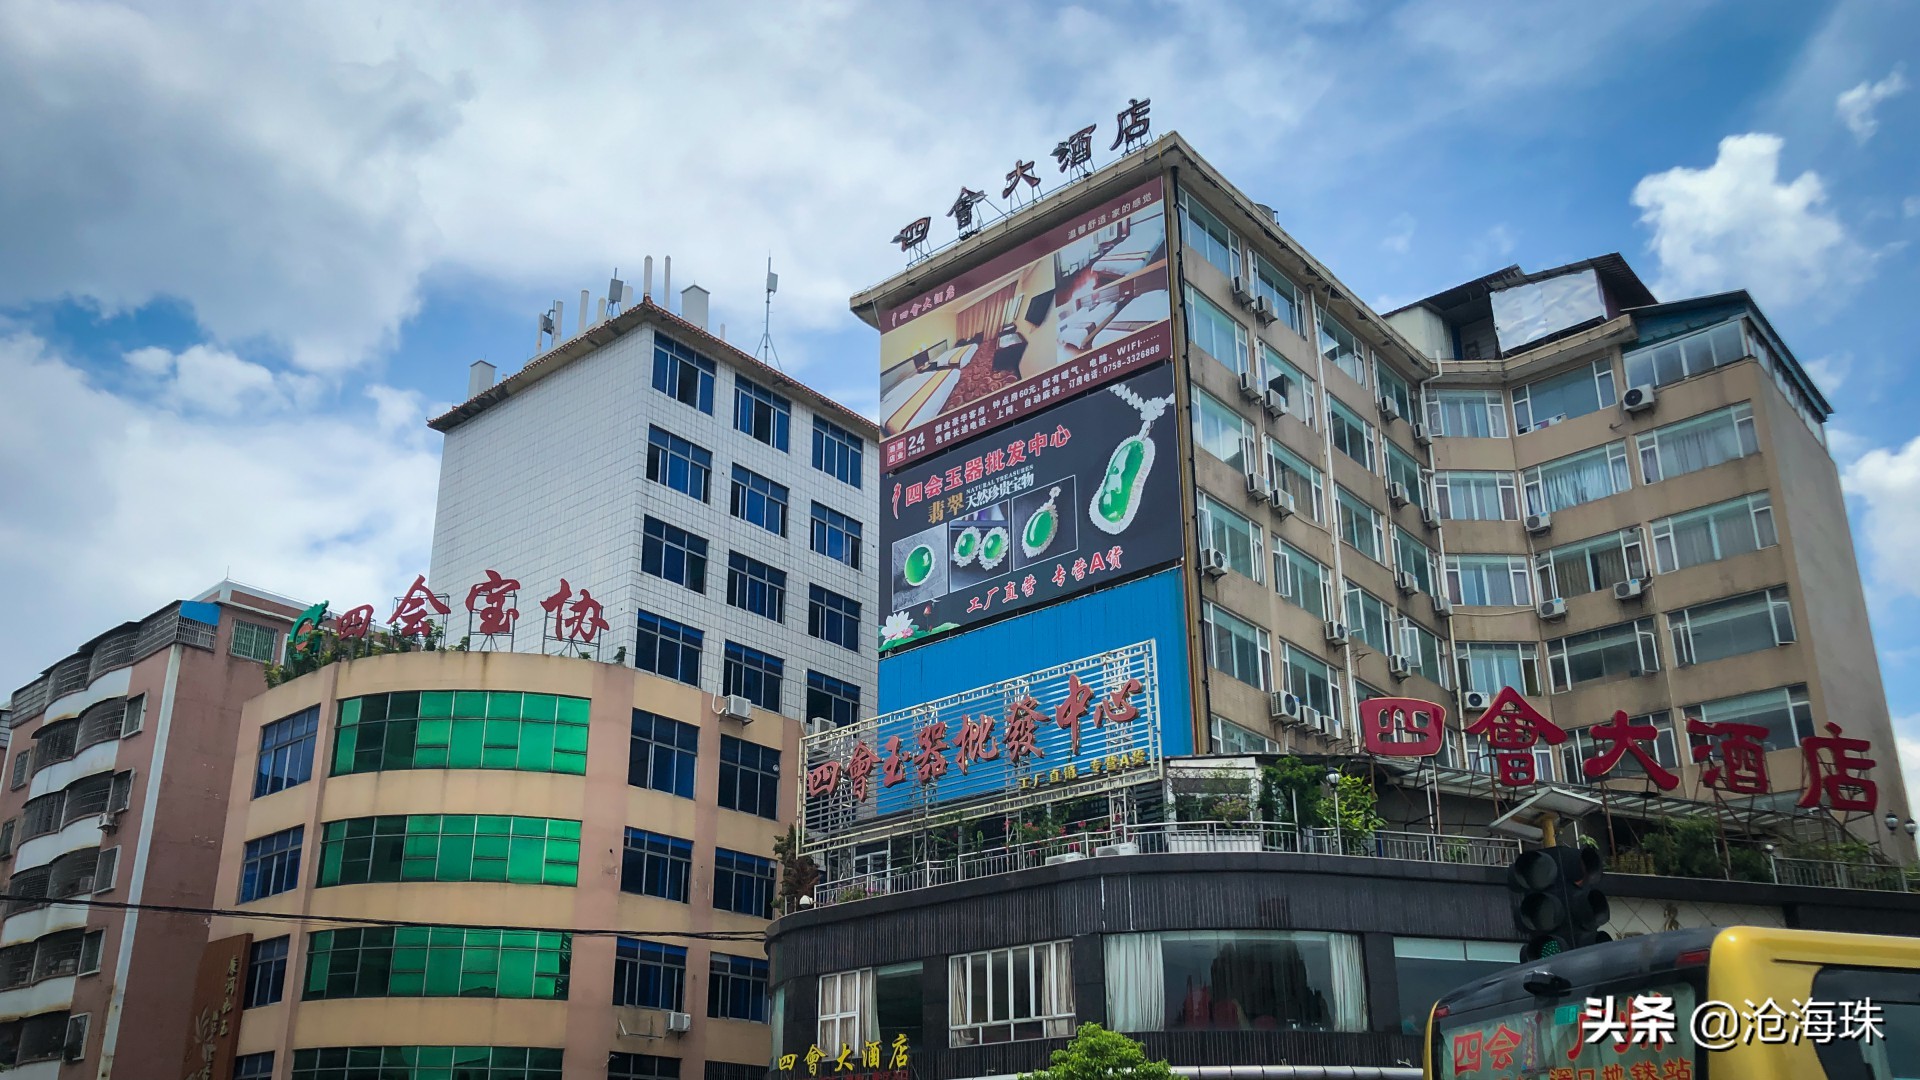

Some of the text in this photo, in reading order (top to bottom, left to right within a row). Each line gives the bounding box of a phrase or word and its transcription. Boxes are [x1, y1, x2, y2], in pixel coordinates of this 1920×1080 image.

[891, 98, 1151, 252] 四會大酒店
[905, 424, 1072, 507] 四会玉器批发中心
[908, 432, 925, 450] 24
[965, 464, 1034, 494] NATURAL TREASURES
[965, 472, 1035, 511] 天然珍贵宝物
[966, 545, 1124, 614] 工厂直营 专营A货
[1359, 685, 1879, 813] 四會大酒店
[778, 1033, 909, 1076] 四會大酒店
[1453, 1023, 1523, 1077] 四会
